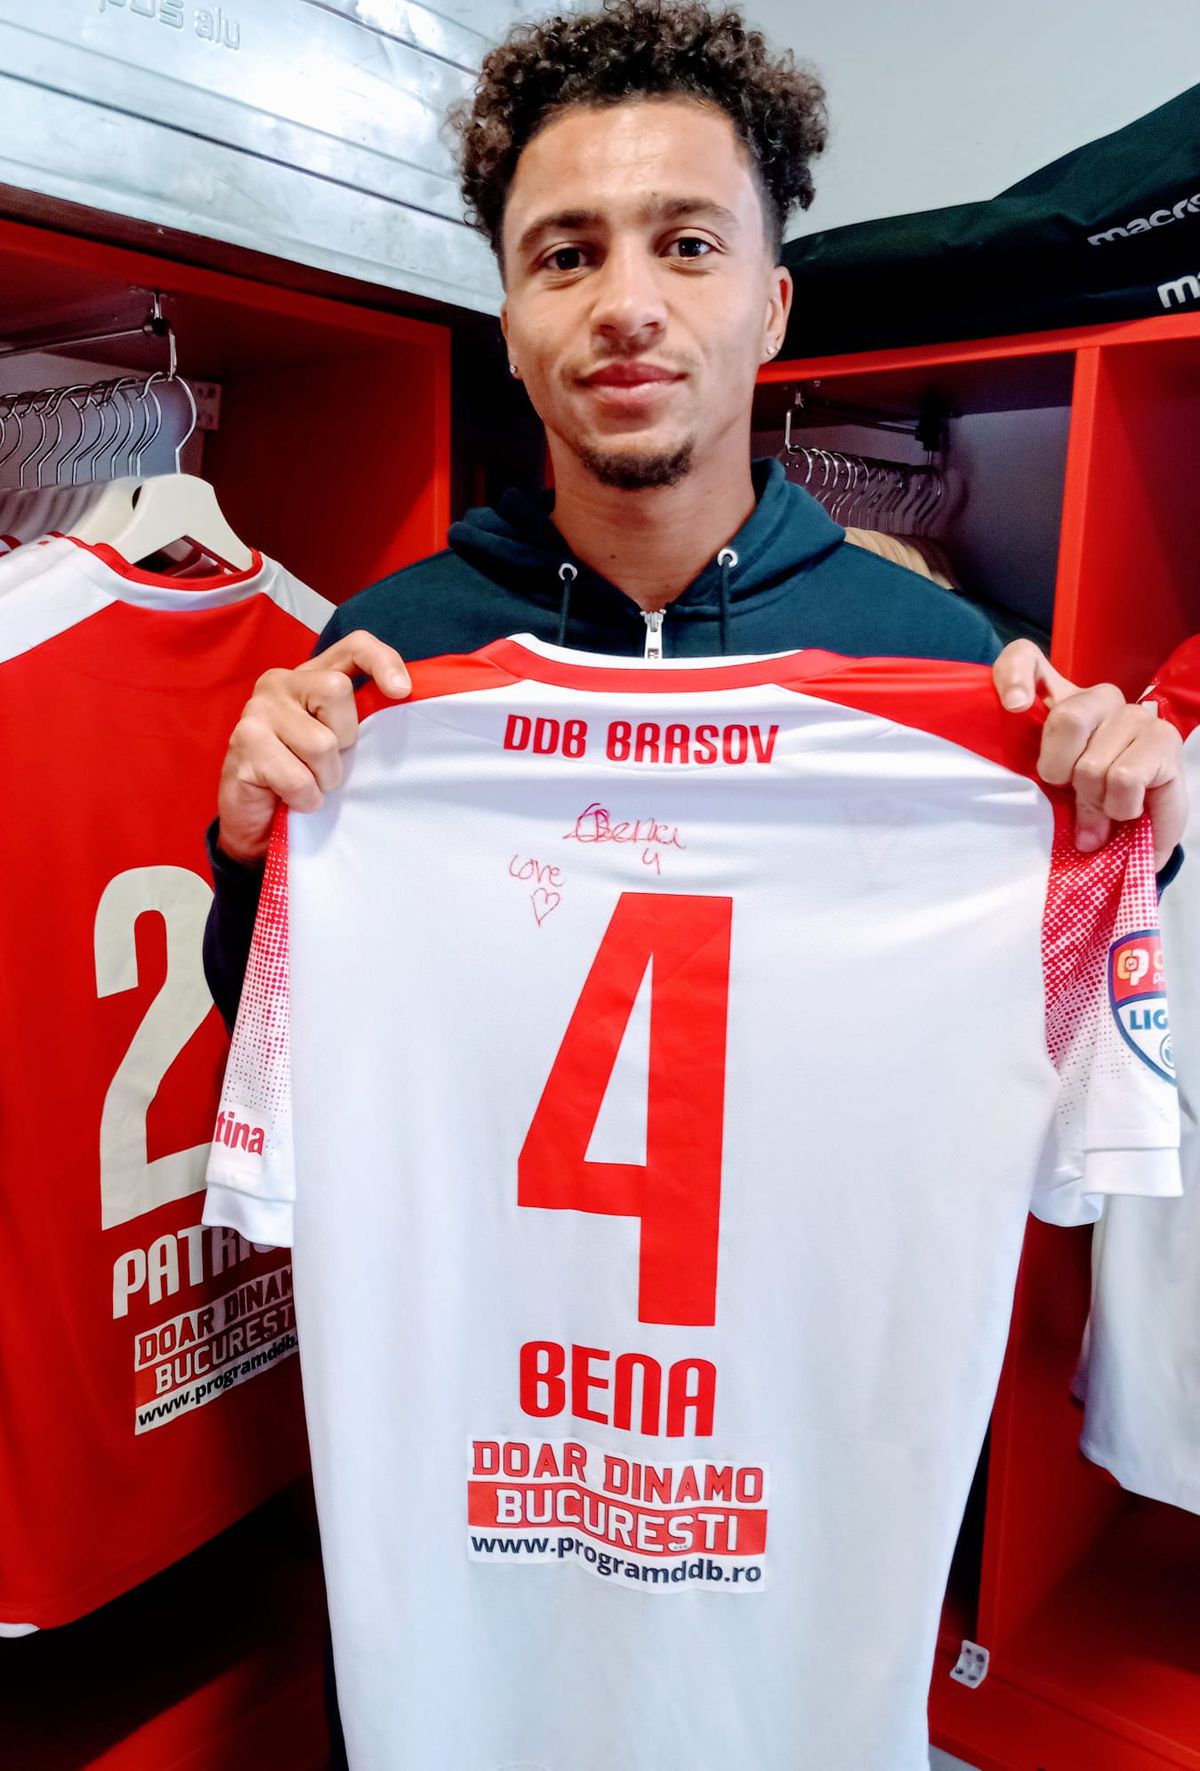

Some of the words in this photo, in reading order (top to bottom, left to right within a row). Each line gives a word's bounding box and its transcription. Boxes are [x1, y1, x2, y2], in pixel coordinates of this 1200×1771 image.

[194, 6, 240, 50] alu
[1157, 272, 1200, 308] m
[502, 713, 588, 759] DDB
[606, 720, 779, 764] BRASOV
[517, 892, 733, 1327] 4
[138, 1307, 215, 1366] DOAR
[519, 1340, 718, 1437] BENA
[472, 1440, 588, 1482] DOAR
[603, 1454, 764, 1505] DINAMO
[471, 1534, 762, 1585] www.programddb.ro
